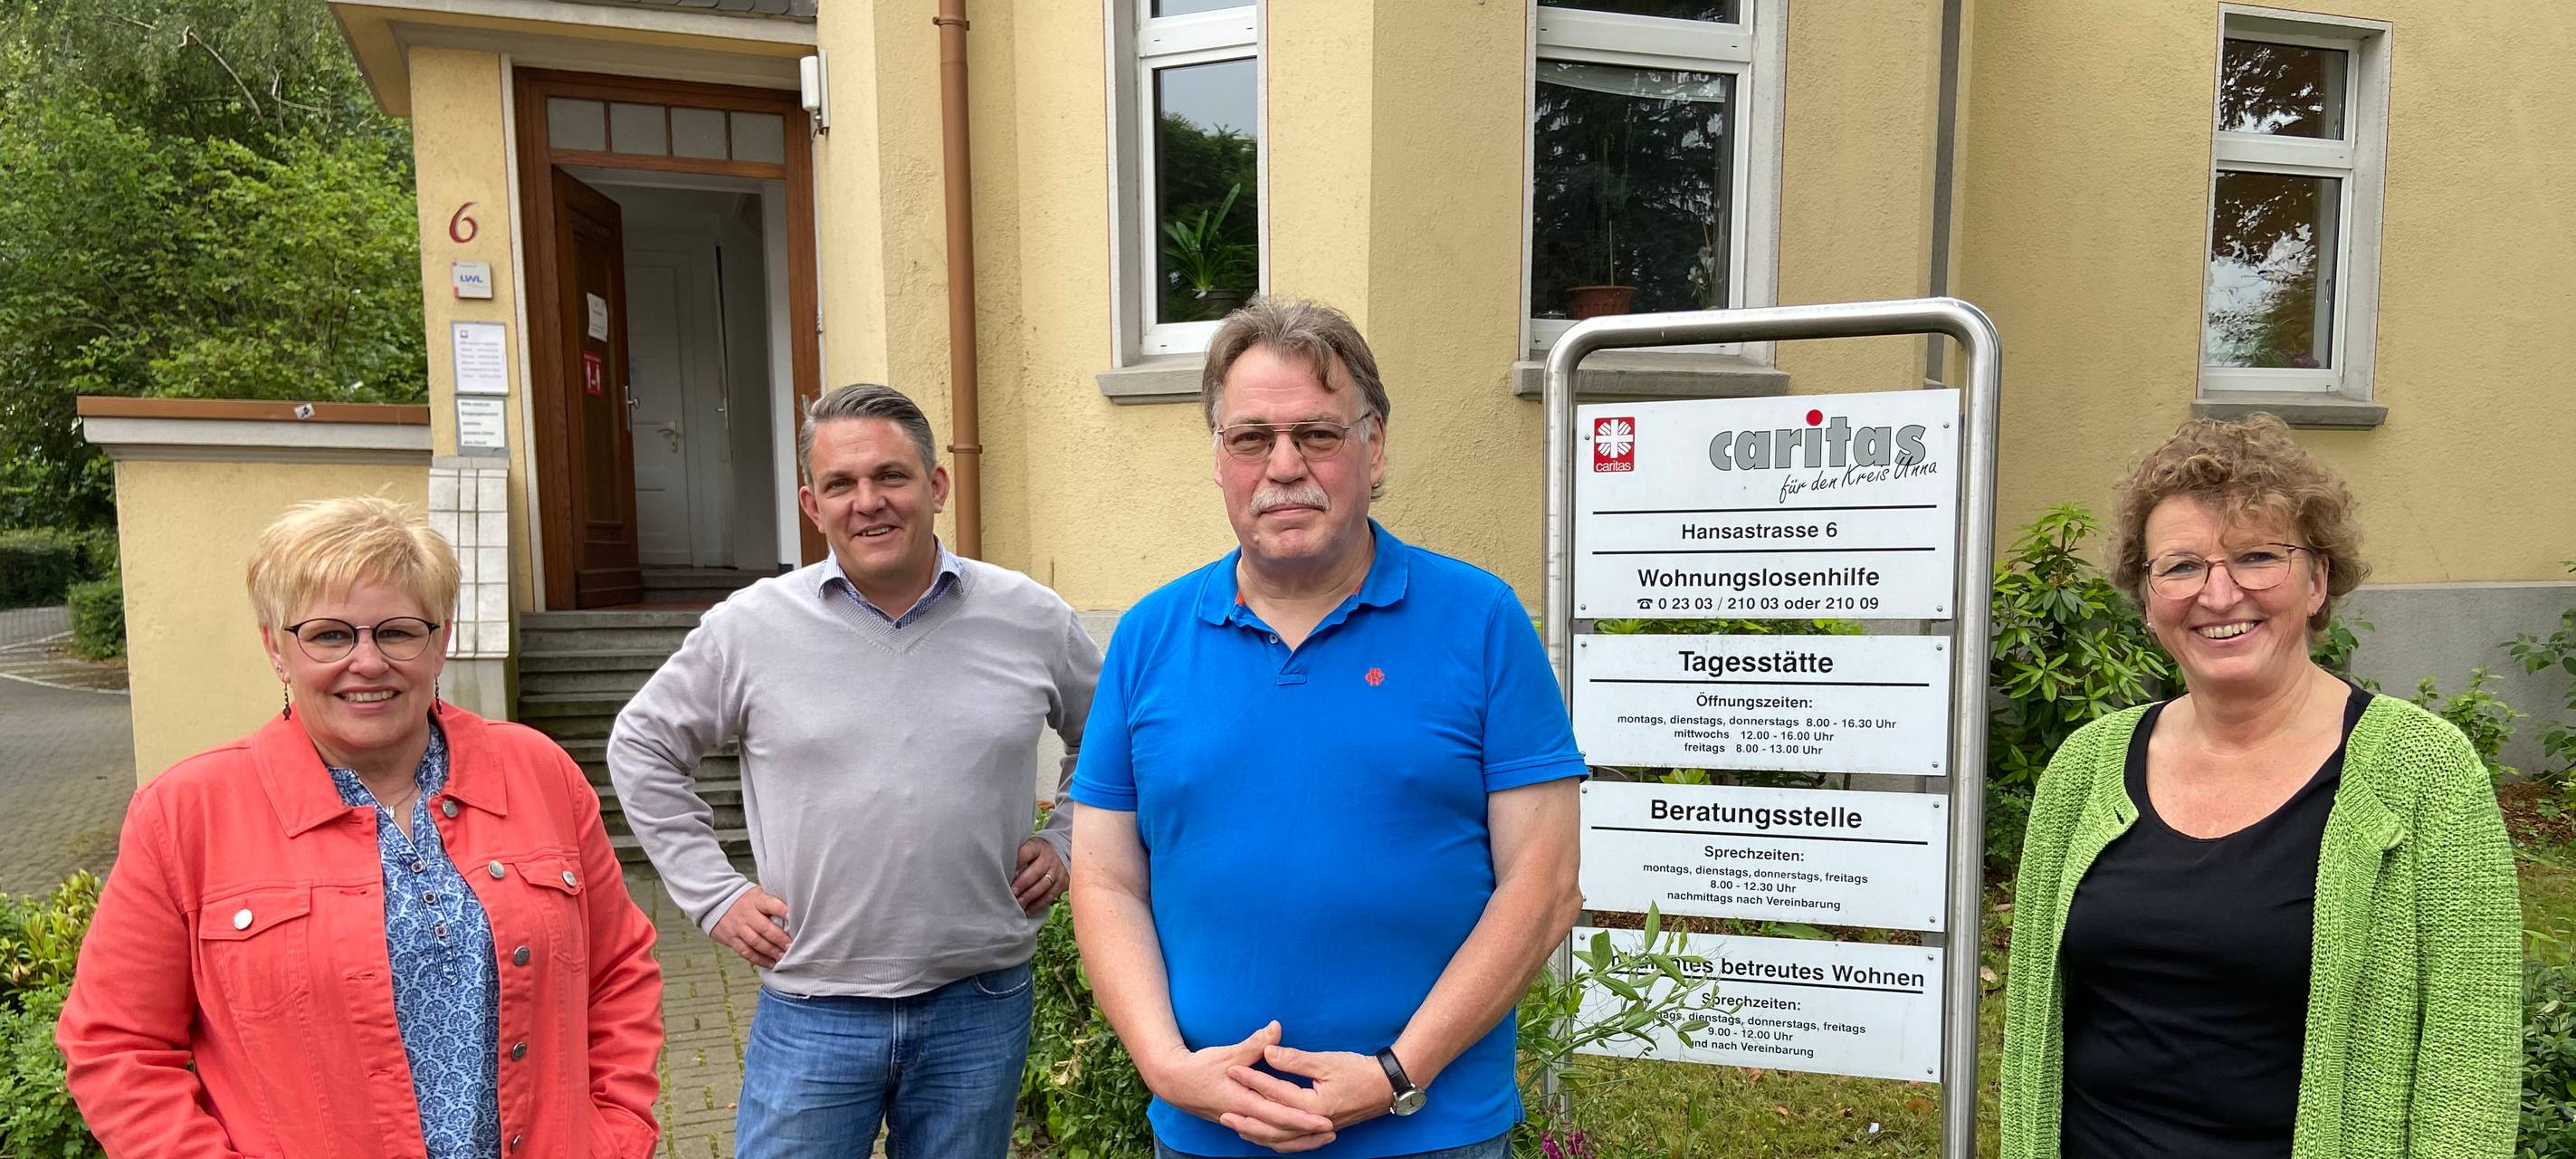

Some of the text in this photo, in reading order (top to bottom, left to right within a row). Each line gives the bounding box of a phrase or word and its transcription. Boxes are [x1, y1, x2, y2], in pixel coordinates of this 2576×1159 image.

[449, 202, 477, 243] 6
[460, 274, 483, 283] LWL
[1709, 408, 1927, 471] caritas
[1596, 460, 1631, 473] caritas
[1779, 455, 1938, 503] für den Kreis Unna
[1682, 522, 1837, 540] Hansastrasse 6
[1637, 567, 1879, 591] Wohnungslosenhilfe
[1658, 597, 1878, 610] 0 23 03 / 210 03 oder 210 09
[1678, 650, 1833, 677] Tagesstätte
[1696, 692, 1812, 711] Öffnungszeiten:
[1617, 715, 1666, 726] montags,
[1670, 715, 1725, 727] dienstags,
[1729, 716, 1799, 728] donnerstags
[1806, 718, 1830, 727] 8.00
[1842, 719, 1872, 728] 16.30
[1876, 719, 1896, 728] Uhr
[1674, 729, 1730, 739] mittwochs
[1741, 731, 1770, 740] 12.00
[1781, 731, 1809, 741] 16.00
[1814, 732, 1834, 742] Uhr
[1684, 742, 1725, 754] freitags
[1736, 744, 1759, 753] 8.00
[1770, 744, 1798, 753] 13.00
[1803, 745, 1823, 754] Uhr
[1651, 800, 1862, 829] Beratungsstelle
[1704, 846, 1804, 862] Sprechzeiten:
[1643, 865, 1868, 886] montags, dienstags, donnerstags, freitags
[1710, 880, 1733, 889] 8.00
[1744, 882, 1773, 892] 12.30
[1777, 883, 1796, 893] Uhr
[1667, 892, 1840, 912] nachmittags nach Vereinbarung
[1721, 957, 1825, 981] betreutes
[1832, 964, 1923, 987] Wohnen
[1701, 992, 1802, 1012] Sprechzeiten:
[1687, 1011, 1744, 1025] dienstags,
[1748, 1016, 1819, 1031] donnerstags,
[1823, 1021, 1865, 1035] freitags
[1708, 1027, 1731, 1037] 9.00
[1741, 1029, 1770, 1040] 12.00
[1774, 1031, 1793, 1041] Uhr
[1712, 1041, 1737, 1050] nach
[1741, 1042, 1814, 1058] Vereinbarung
